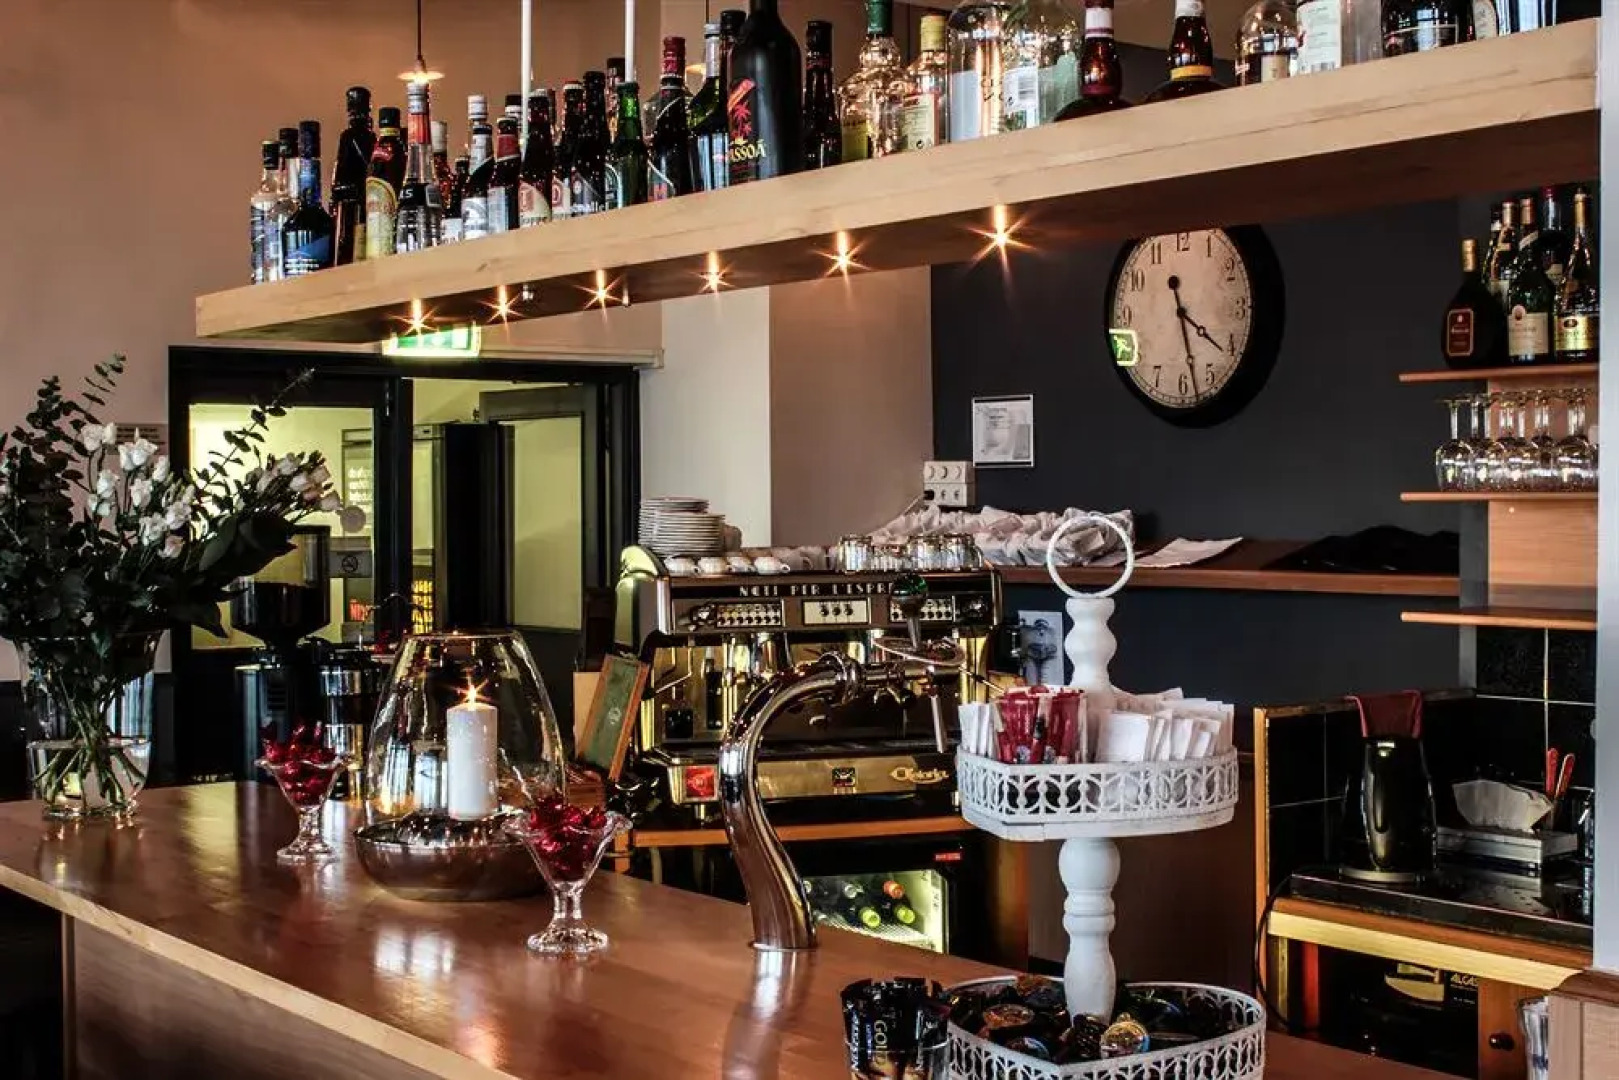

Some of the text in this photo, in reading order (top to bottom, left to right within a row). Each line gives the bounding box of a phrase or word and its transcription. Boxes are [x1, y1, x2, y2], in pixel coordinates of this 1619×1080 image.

[1150, 242, 1162, 265] 11
[1176, 232, 1190, 252] 12
[1206, 235, 1212, 257] 1
[1129, 269, 1145, 292] 10
[1223, 257, 1236, 282] 2
[1121, 307, 1133, 326] 9
[1235, 297, 1246, 320] 3
[1227, 333, 1236, 357] 4
[1152, 365, 1162, 388] 7
[1178, 373, 1189, 395] 6
[1205, 363, 1215, 385] 5
